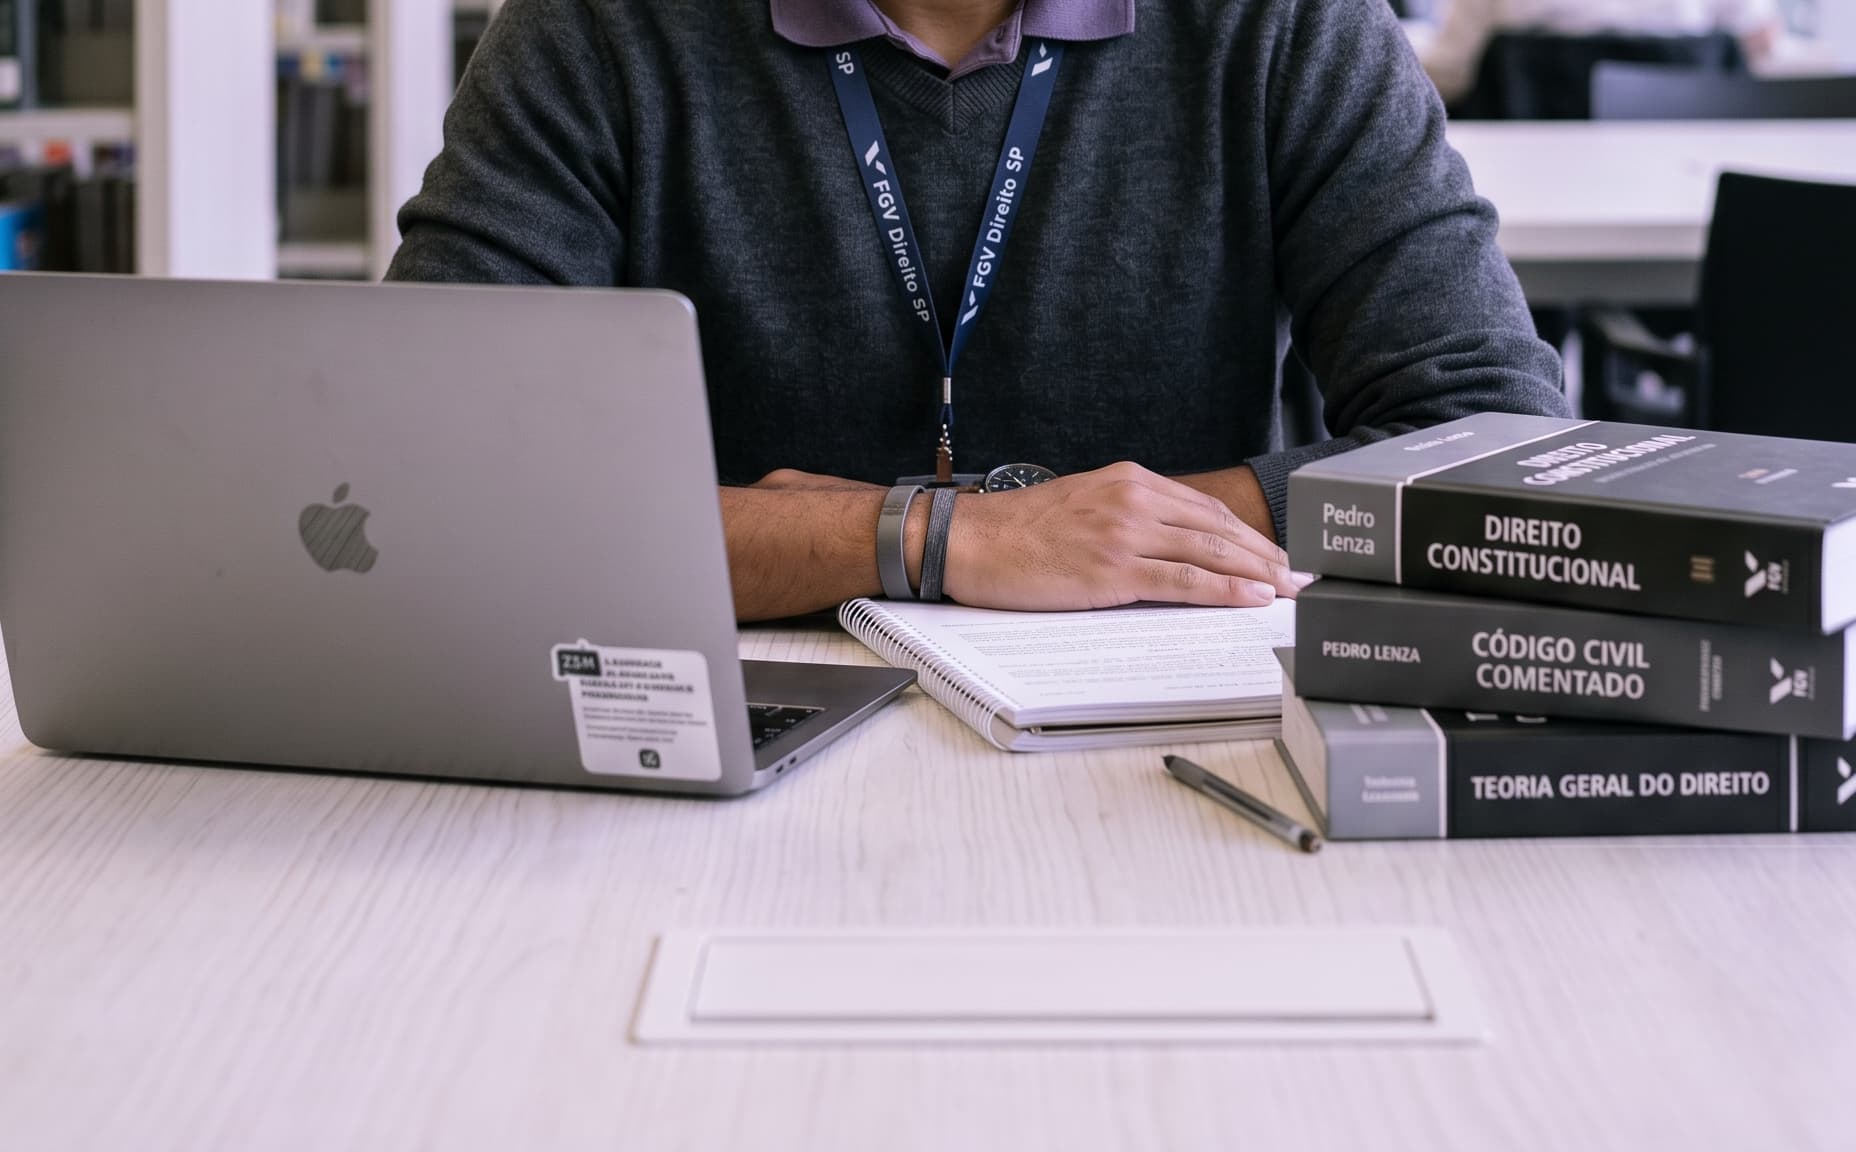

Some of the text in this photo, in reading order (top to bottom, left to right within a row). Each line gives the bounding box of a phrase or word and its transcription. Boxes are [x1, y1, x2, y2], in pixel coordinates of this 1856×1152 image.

[836, 51, 855, 75] SP
[972, 146, 1025, 288] FGV Direito SP
[872, 179, 931, 323] FGV Direito SP
[1516, 441, 1609, 469] DIREITO
[1522, 433, 1698, 487] CONSTITUCIONAL
[1322, 502, 1376, 529] Pedro
[1484, 514, 1582, 550] DIREITO
[1322, 529, 1376, 556] Lenza
[1426, 542, 1642, 592] CONSTITUCIONAL
[1322, 640, 1422, 664] PEDRO LENZA
[1471, 628, 1651, 669] CÓDIGO CIVIL
[1475, 662, 1646, 700] COMENTADO
[1470, 770, 1771, 800] TEORIA GERAL DO DIREITO
